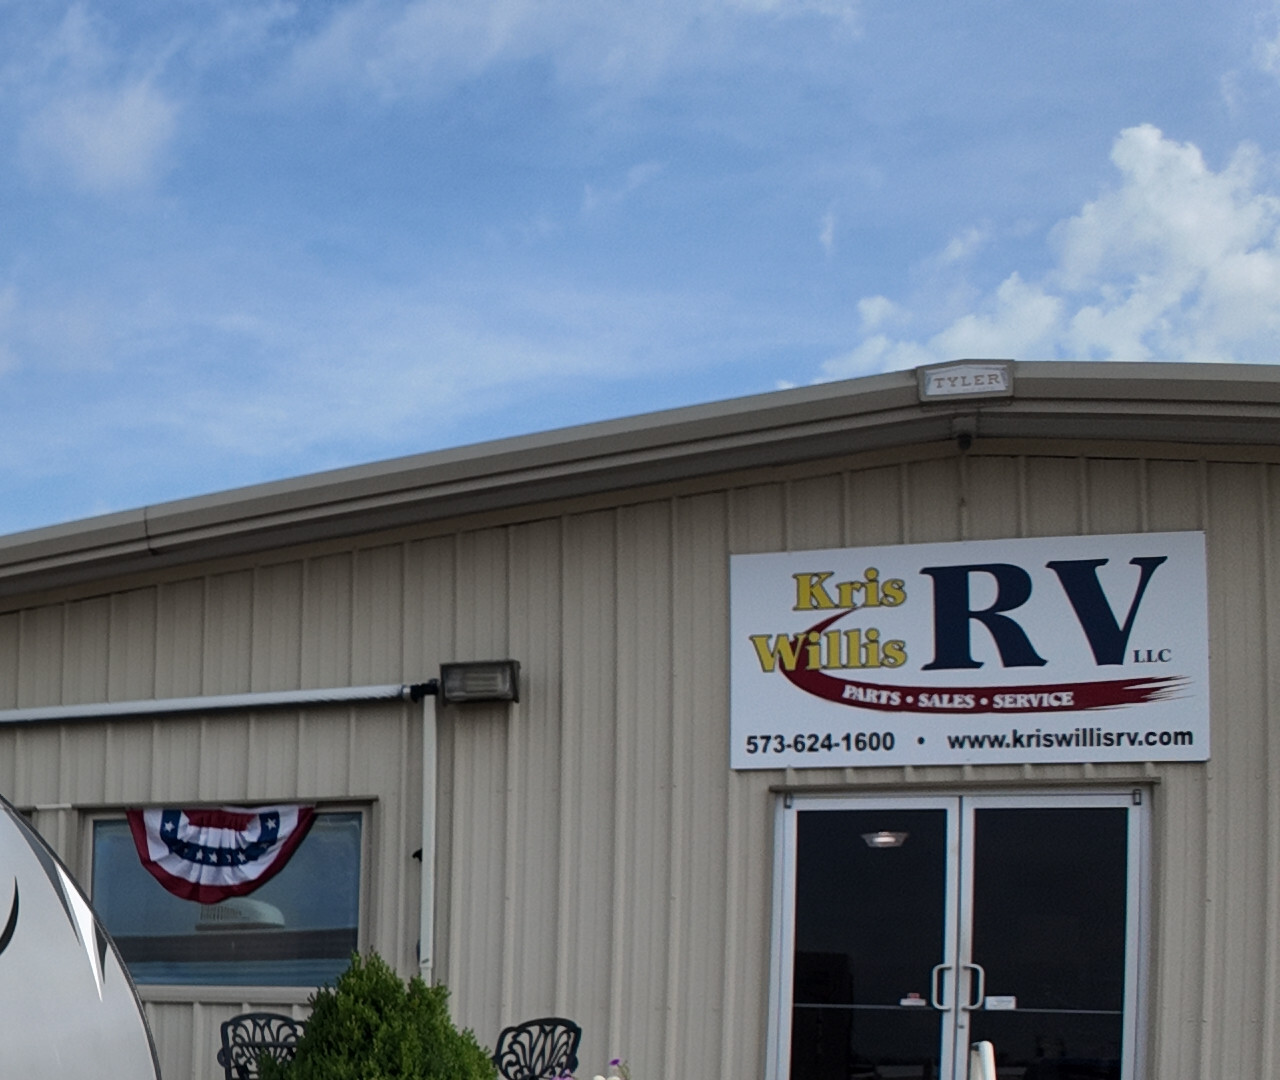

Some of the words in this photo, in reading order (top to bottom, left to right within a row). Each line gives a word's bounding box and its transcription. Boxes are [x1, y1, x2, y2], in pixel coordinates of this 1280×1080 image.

[933, 374, 1001, 389] TYLER
[792, 566, 907, 612] Kris
[919, 555, 1168, 671] RV
[1133, 648, 1173, 664] LLC
[748, 627, 908, 673] Willis
[842, 684, 902, 706] PARTS
[917, 693, 976, 709] SALES
[992, 692, 1075, 709] SERVICE
[745, 731, 896, 754] 573-624-1600
[947, 727, 1194, 750] www.kriswillisrv.com
